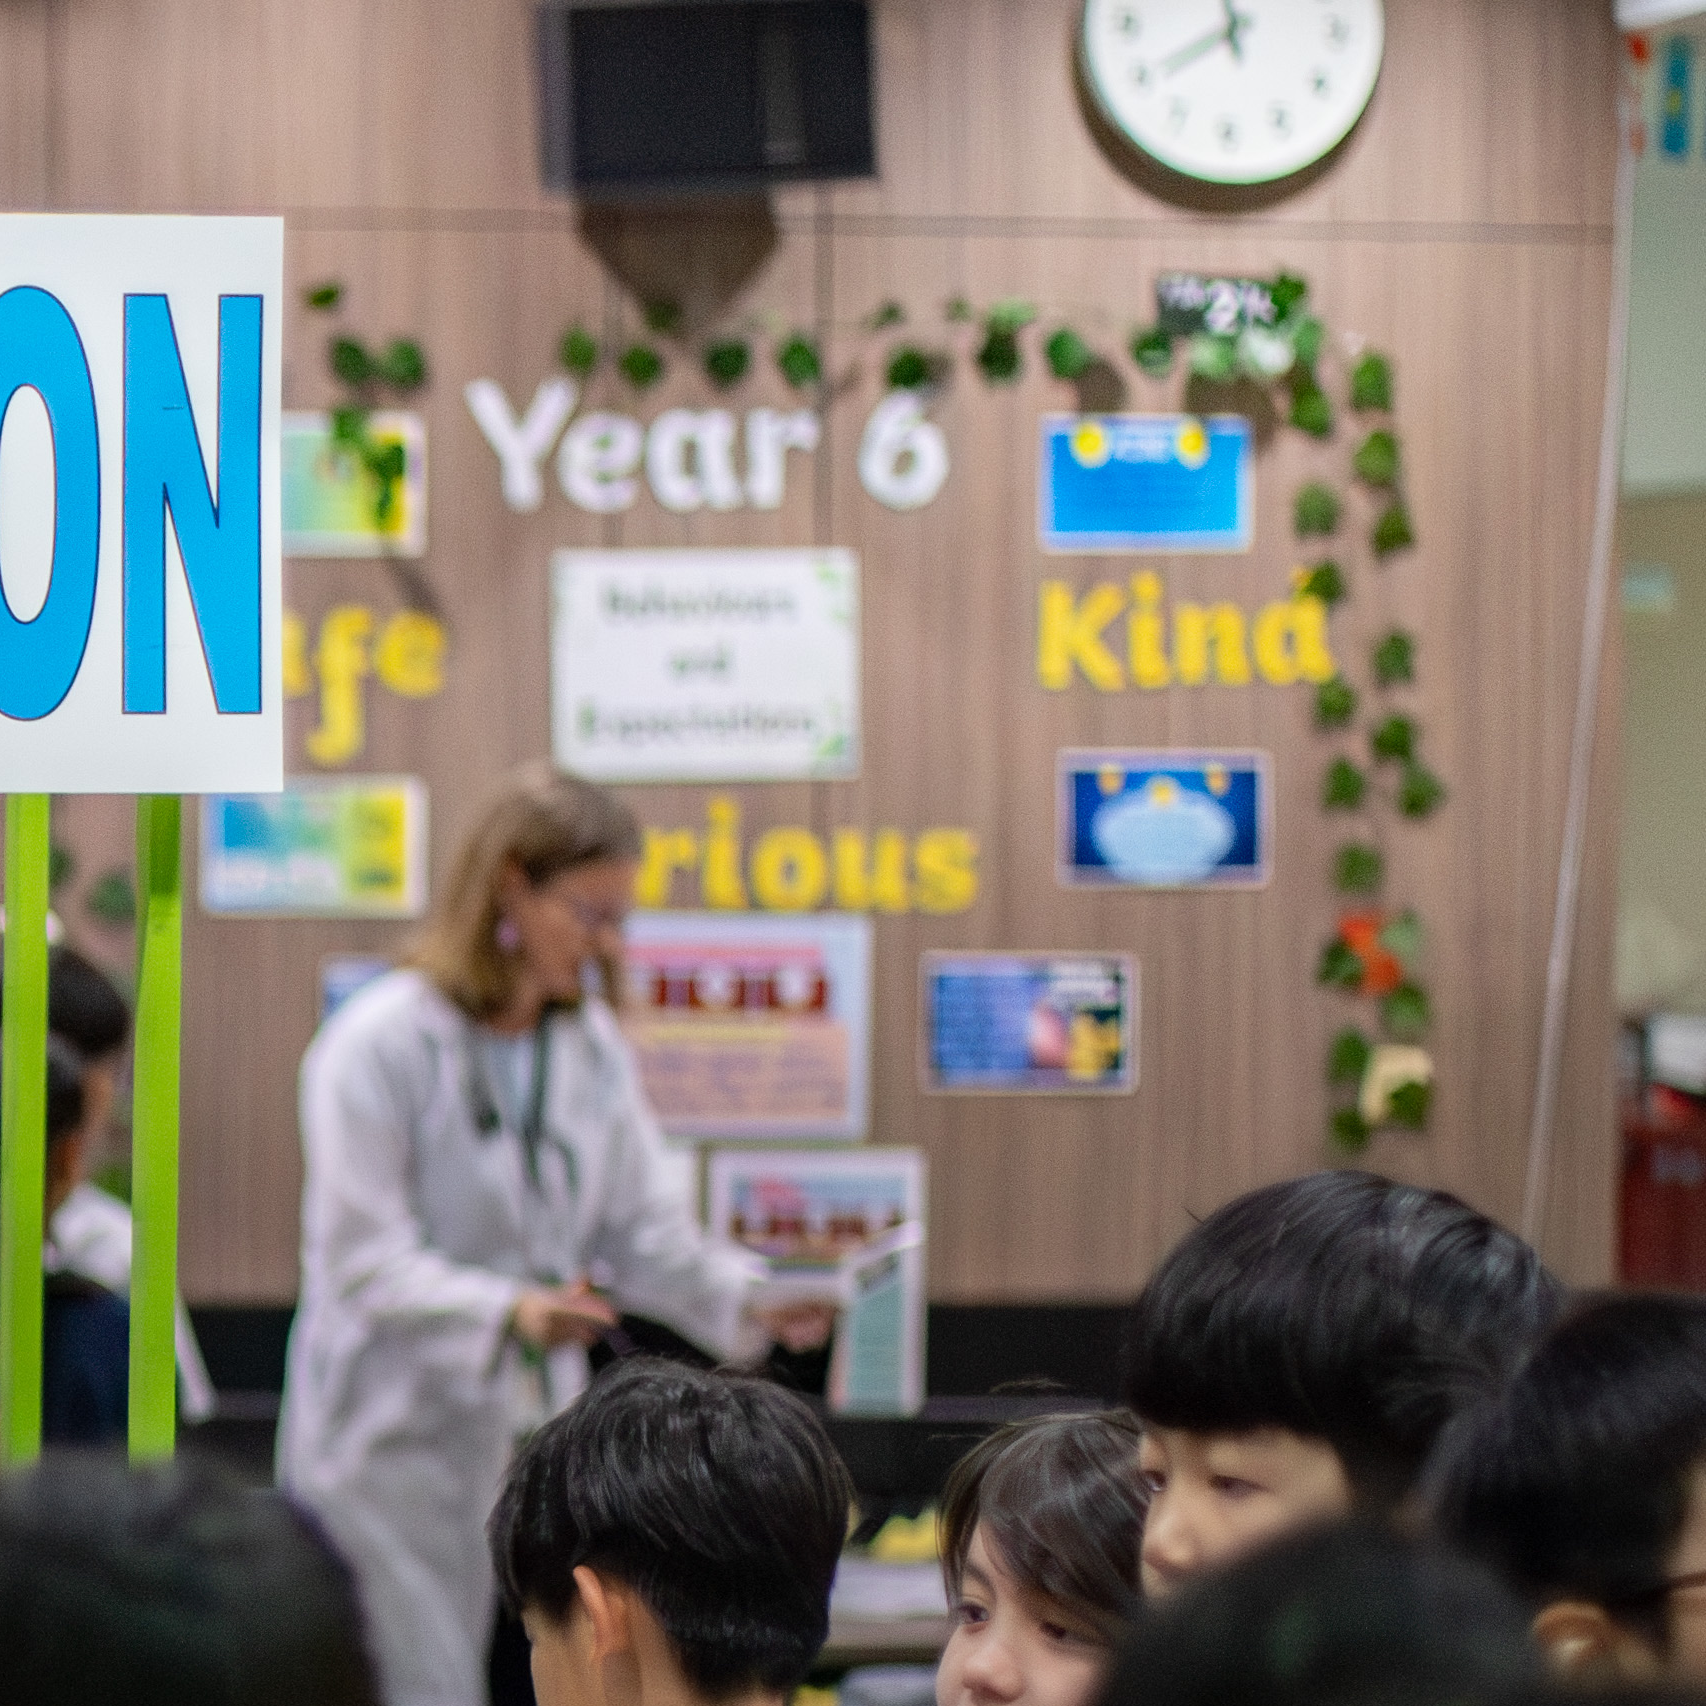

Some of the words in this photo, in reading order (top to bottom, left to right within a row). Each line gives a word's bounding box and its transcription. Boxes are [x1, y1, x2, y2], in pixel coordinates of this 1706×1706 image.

[464, 376, 821, 513] Year
[857, 386, 950, 512] 6
[1040, 565, 1337, 692] Kind
